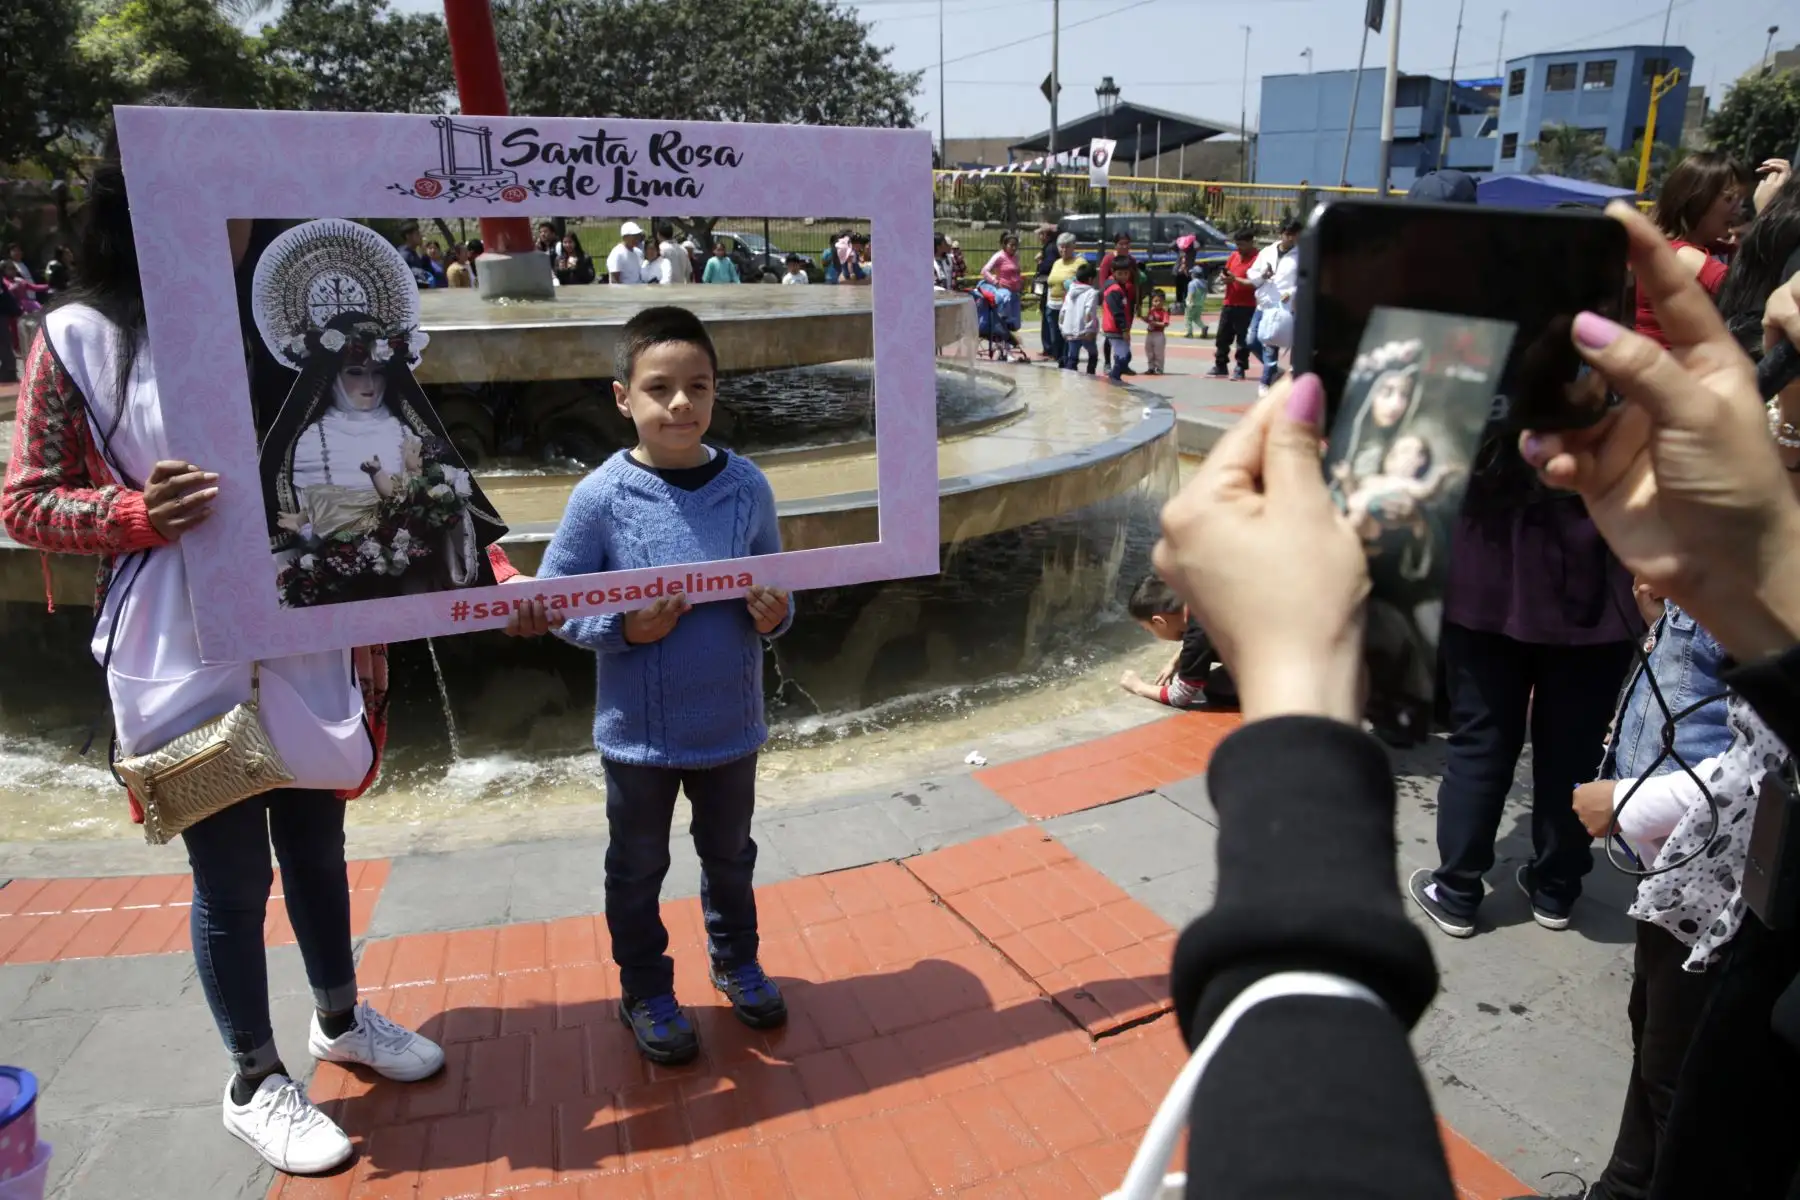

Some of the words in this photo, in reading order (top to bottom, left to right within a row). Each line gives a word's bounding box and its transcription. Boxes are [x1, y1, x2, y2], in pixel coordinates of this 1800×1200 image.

[501, 128, 637, 167] Santa
[649, 130, 744, 173] Rosa
[549, 165, 600, 201] de
[605, 165, 704, 207] Lima
